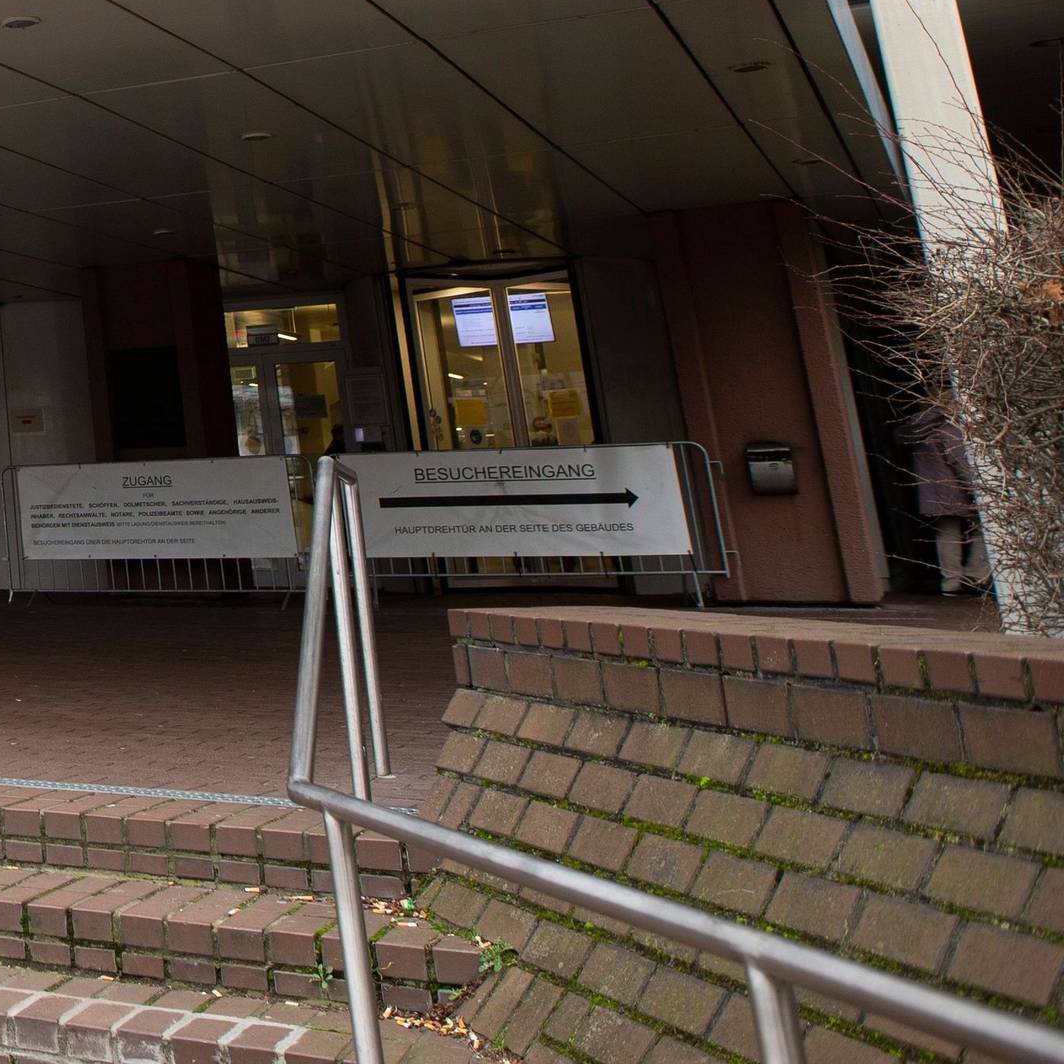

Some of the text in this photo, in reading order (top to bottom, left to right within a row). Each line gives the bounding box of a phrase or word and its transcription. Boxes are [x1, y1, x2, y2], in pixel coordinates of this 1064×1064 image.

[414, 463, 596, 483] BESUCHEREINGANG
[122, 475, 172, 488] ZUGANG
[478, 524, 493, 534] AN
[494, 524, 517, 533] DER
[519, 523, 550, 533] SEITE
[551, 523, 574, 532] DES
[575, 521, 635, 532] GEBÄUDES
